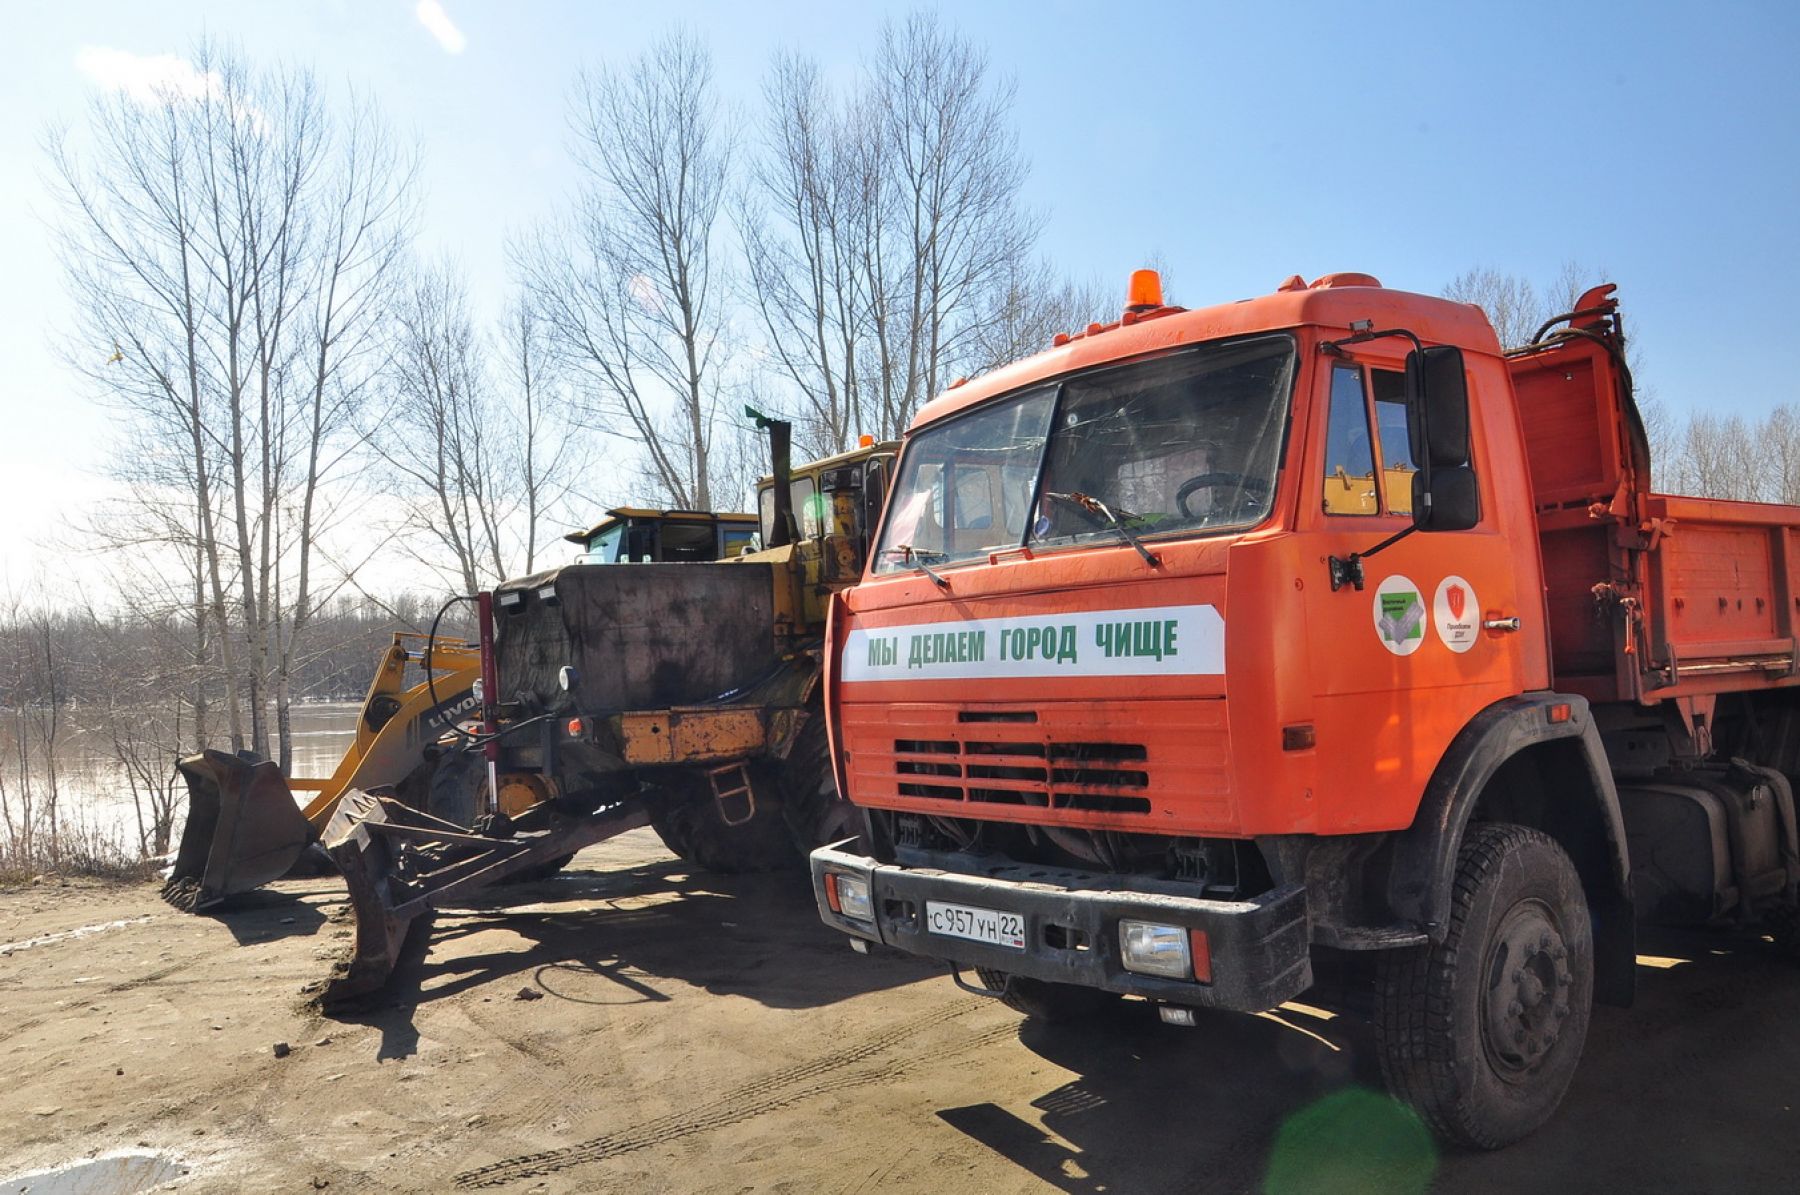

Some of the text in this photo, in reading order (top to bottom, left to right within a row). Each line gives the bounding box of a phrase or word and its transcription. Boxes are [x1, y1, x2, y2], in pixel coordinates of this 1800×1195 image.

[868, 620, 1178, 669] МЫ ДЕЛАЕМ ГОРОД ЧИЩЕ
[1001, 916, 1019, 936] 22
